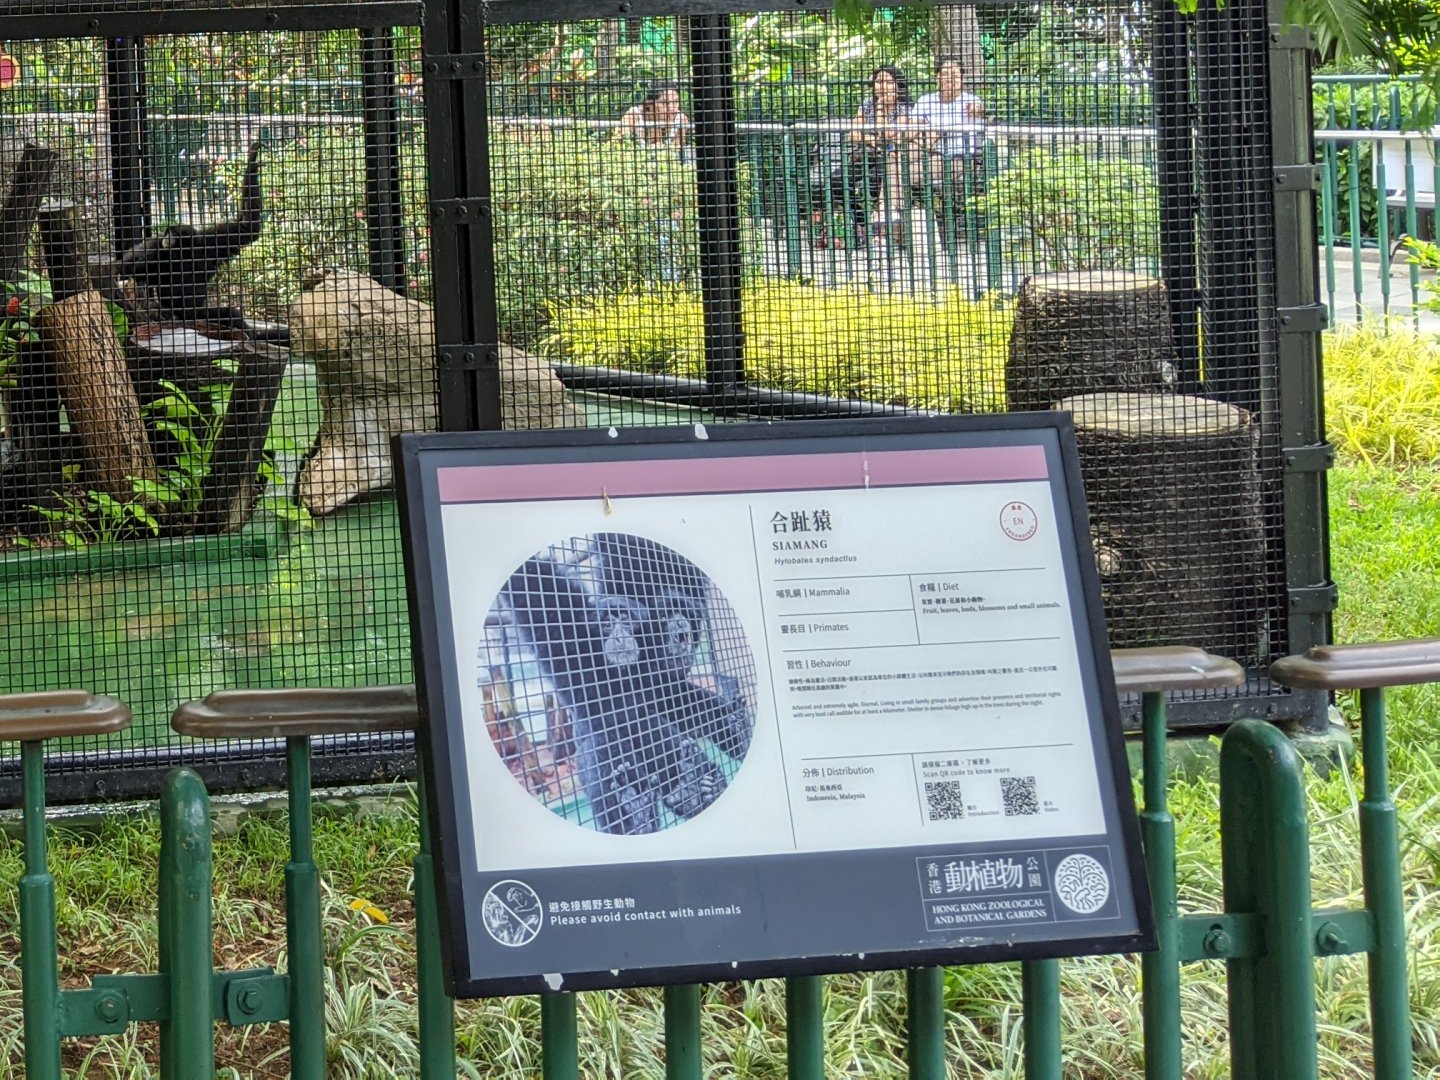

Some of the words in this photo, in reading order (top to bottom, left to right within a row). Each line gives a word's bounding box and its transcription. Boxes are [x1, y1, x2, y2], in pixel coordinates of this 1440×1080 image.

[770, 509, 832, 533] 合趾猿
[1013, 517, 1023, 525] EN
[772, 540, 828, 551] SIAMANG
[774, 556, 813, 566] Hylobates
[809, 586, 850, 597] Mammalia
[943, 582, 959, 591] Diet
[1007, 602, 1018, 610] and
[1019, 602, 1035, 610] small
[813, 622, 849, 633] Primates
[787, 660, 804, 670] 習性
[810, 658, 851, 669] Behaviour
[803, 768, 819, 778] 分佈
[827, 765, 875, 777] Distribution
[923, 770, 938, 778] Scan
[940, 770, 949, 778] QR
[950, 769, 965, 777] code
[976, 767, 992, 775] know
[994, 766, 1011, 774] more
[839, 792, 866, 801] Malaysia
[944, 858, 1023, 893] 動植物
[548, 897, 636, 913] 避免接觸野生動物
[932, 903, 960, 915] HONG
[961, 902, 987, 913] KONG
[988, 898, 1046, 911] ZOOLOGICAL
[550, 914, 587, 926] Please
[590, 911, 621, 923] avoid
[624, 909, 667, 921] contact
[669, 906, 694, 919] with
[697, 904, 742, 916] animals
[934, 914, 954, 925] AND
[954, 911, 1005, 924] BOTANICAL
[1006, 908, 1048, 921] GARDENS
